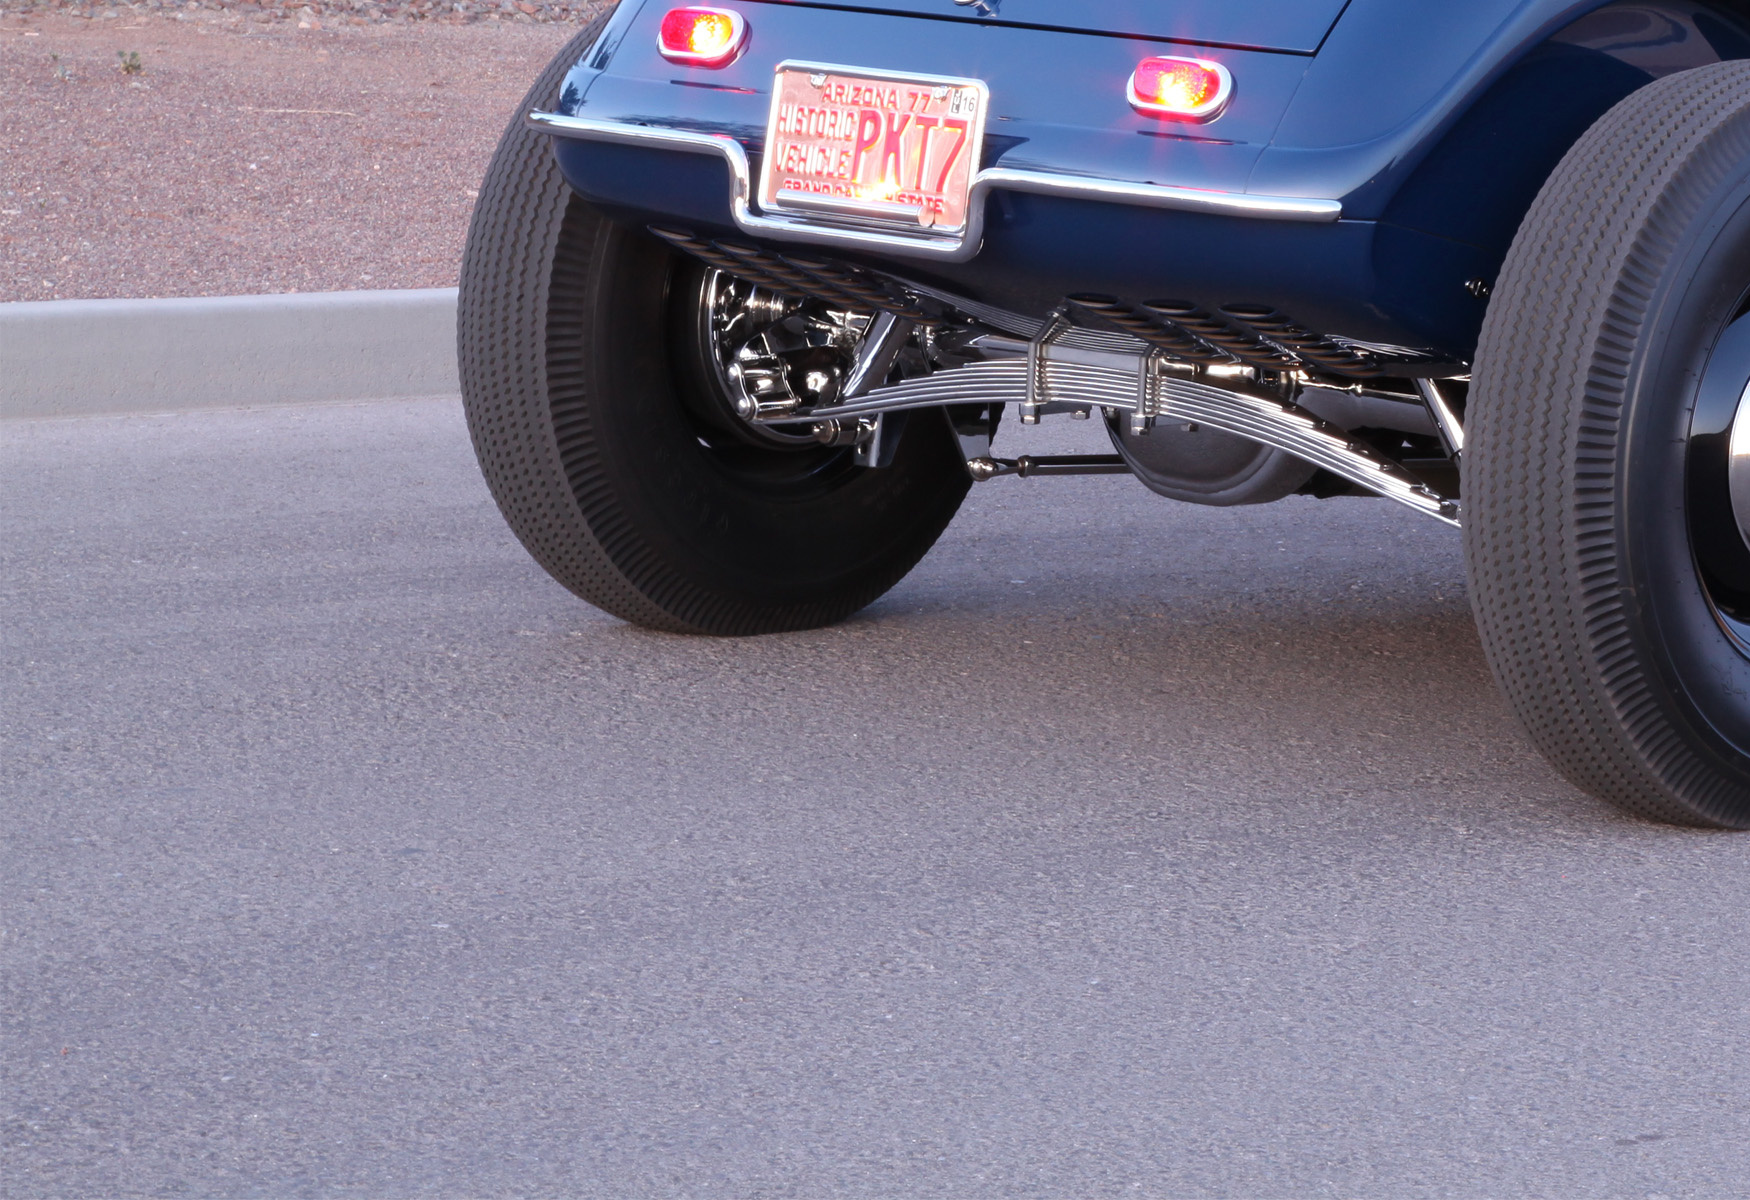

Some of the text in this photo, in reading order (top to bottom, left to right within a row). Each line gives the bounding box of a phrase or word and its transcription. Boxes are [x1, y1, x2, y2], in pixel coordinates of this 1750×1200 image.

[822, 82, 931, 112] ARIZONA 77
[963, 96, 975, 112] 16
[779, 104, 858, 141] HISTORIC
[775, 143, 852, 178] VEHICLE
[852, 109, 969, 193] PKT7
